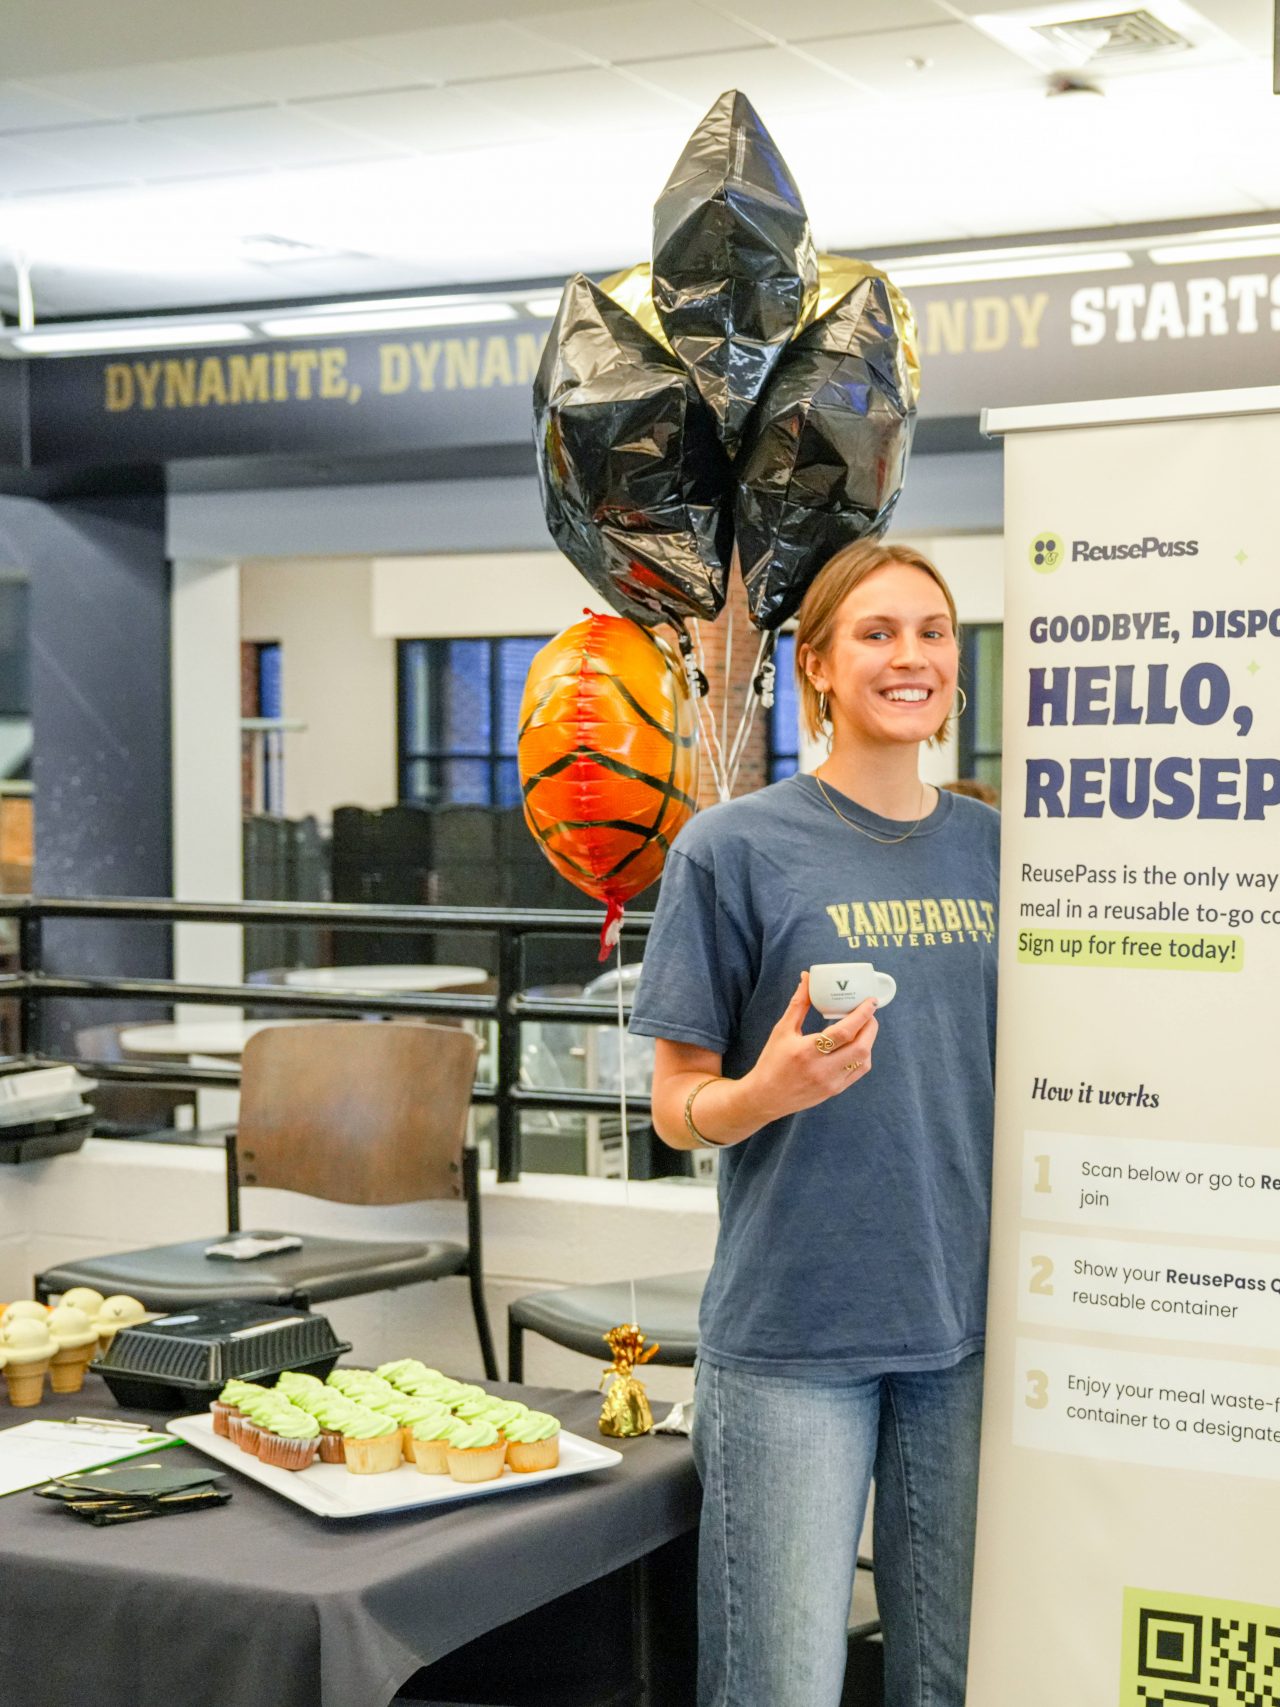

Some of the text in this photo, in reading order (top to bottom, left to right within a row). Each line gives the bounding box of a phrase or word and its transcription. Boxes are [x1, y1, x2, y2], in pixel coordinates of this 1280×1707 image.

[105, 347, 362, 411] DYNAMITE,
[919, 292, 1048, 356] NDY
[1071, 537, 1199, 562] ReusePass
[1030, 612, 1180, 644] GOODBYE,
[1027, 662, 1253, 736] HELLO,
[1021, 863, 1117, 884] ReusePass
[1123, 865, 1137, 884] is
[1143, 865, 1177, 885] the
[1183, 866, 1230, 891] only
[1235, 873, 1279, 892] way
[827, 900, 994, 937] VANDERBILT
[1020, 898, 1061, 918] meal
[1066, 899, 1083, 918] in
[1088, 905, 1099, 919] a
[1104, 901, 1190, 922] reusable
[1196, 904, 1254, 927] to-go
[848, 931, 994, 948] UNIVERSITY
[1018, 932, 1237, 963] Sign up for free today!
[1031, 1077, 1160, 1109] How it works
[1033, 1154, 1052, 1194] 1
[1081, 1161, 1122, 1180] Scan
[1127, 1164, 1180, 1184] below
[1185, 1170, 1204, 1184] or
[1209, 1173, 1232, 1190] go
[1238, 1171, 1255, 1188] to
[1079, 1189, 1109, 1209] join
[1029, 1255, 1055, 1296] 2
[1073, 1260, 1118, 1279] Show
[1122, 1267, 1161, 1284] your
[1166, 1269, 1266, 1292] ReusePass
[1072, 1288, 1238, 1319] reusable container
[1025, 1369, 1049, 1410] 3
[1067, 1375, 1111, 1398] Enjoy
[1115, 1382, 1154, 1402] your
[1159, 1384, 1205, 1405] meal
[1066, 1405, 1148, 1429] container
[1152, 1413, 1171, 1430] to
[1175, 1420, 1188, 1432] a
